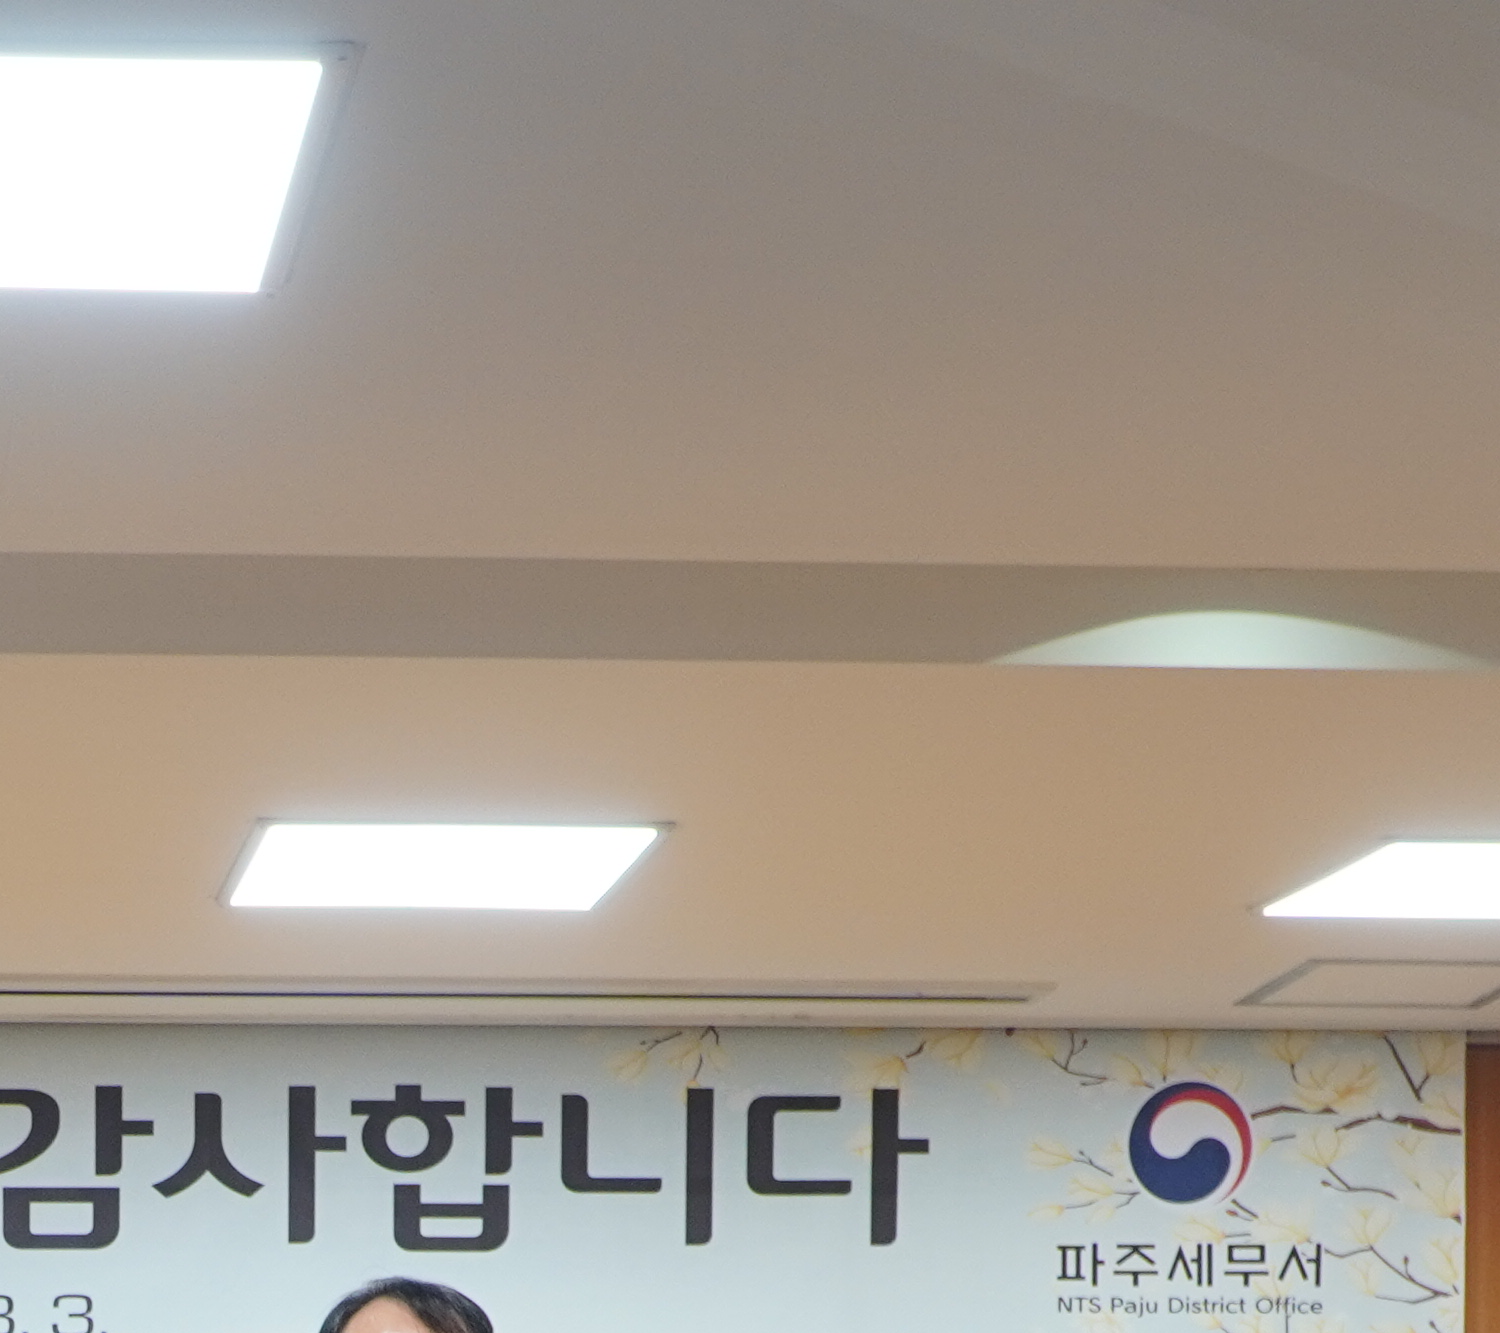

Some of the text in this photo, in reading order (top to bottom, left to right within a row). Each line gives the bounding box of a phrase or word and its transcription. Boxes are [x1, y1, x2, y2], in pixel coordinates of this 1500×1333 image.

[1056, 1242, 1323, 1288] 파주세무서
[1057, 1296, 1324, 1318] NTS Paju District Office
